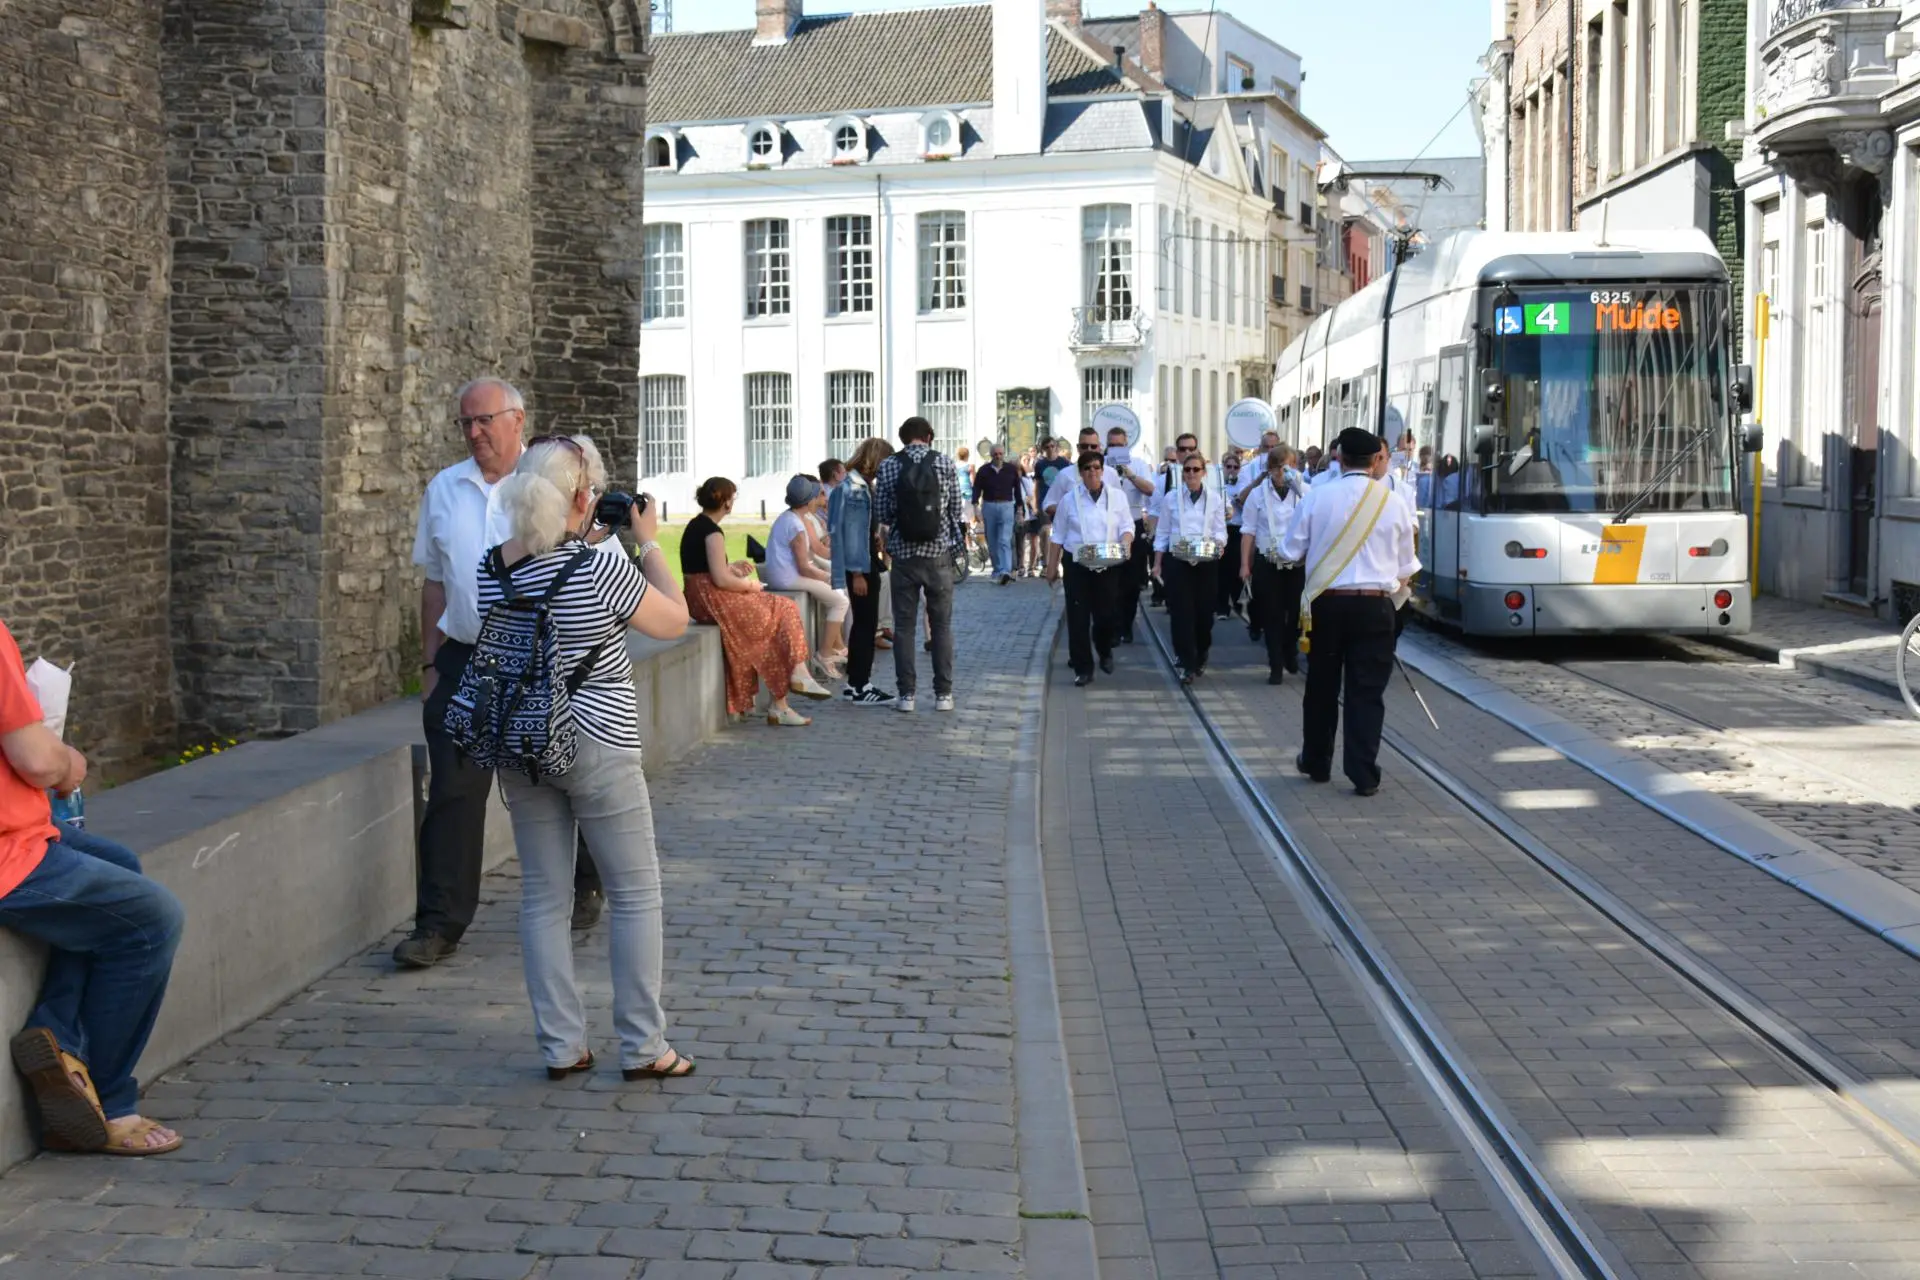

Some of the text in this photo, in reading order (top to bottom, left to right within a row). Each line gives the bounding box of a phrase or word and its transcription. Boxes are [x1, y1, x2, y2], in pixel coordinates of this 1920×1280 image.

[1590, 291, 1630, 304] 6325
[1535, 301, 1680, 332] 4 Muide
